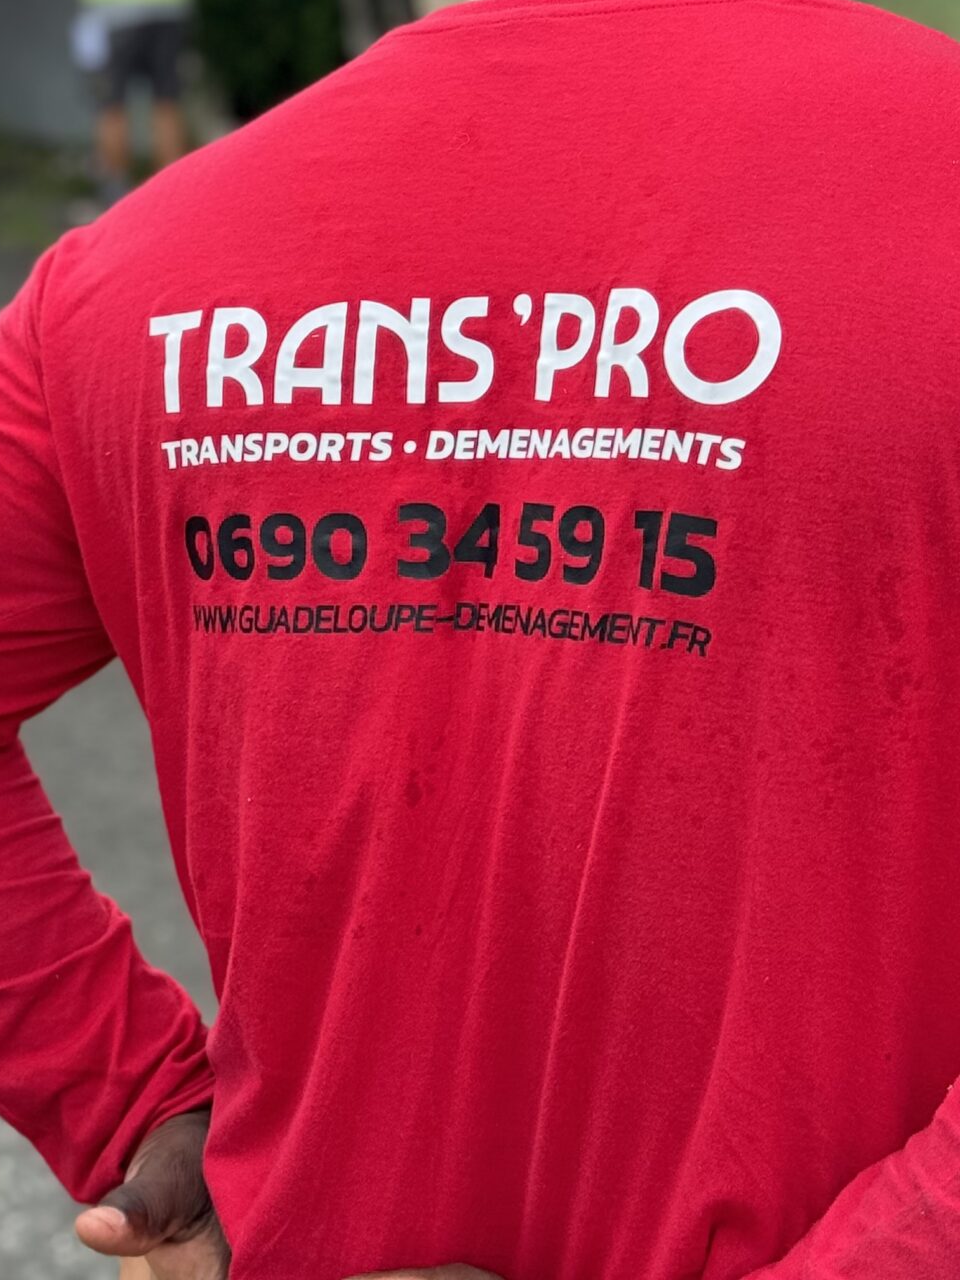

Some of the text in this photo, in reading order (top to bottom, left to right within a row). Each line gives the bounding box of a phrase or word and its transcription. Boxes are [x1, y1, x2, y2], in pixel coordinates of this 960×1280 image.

[162, 428, 746, 471] TRANSPORTS DEMENAGEMENTS
[185, 502, 718, 597] 0690 34 59 15
